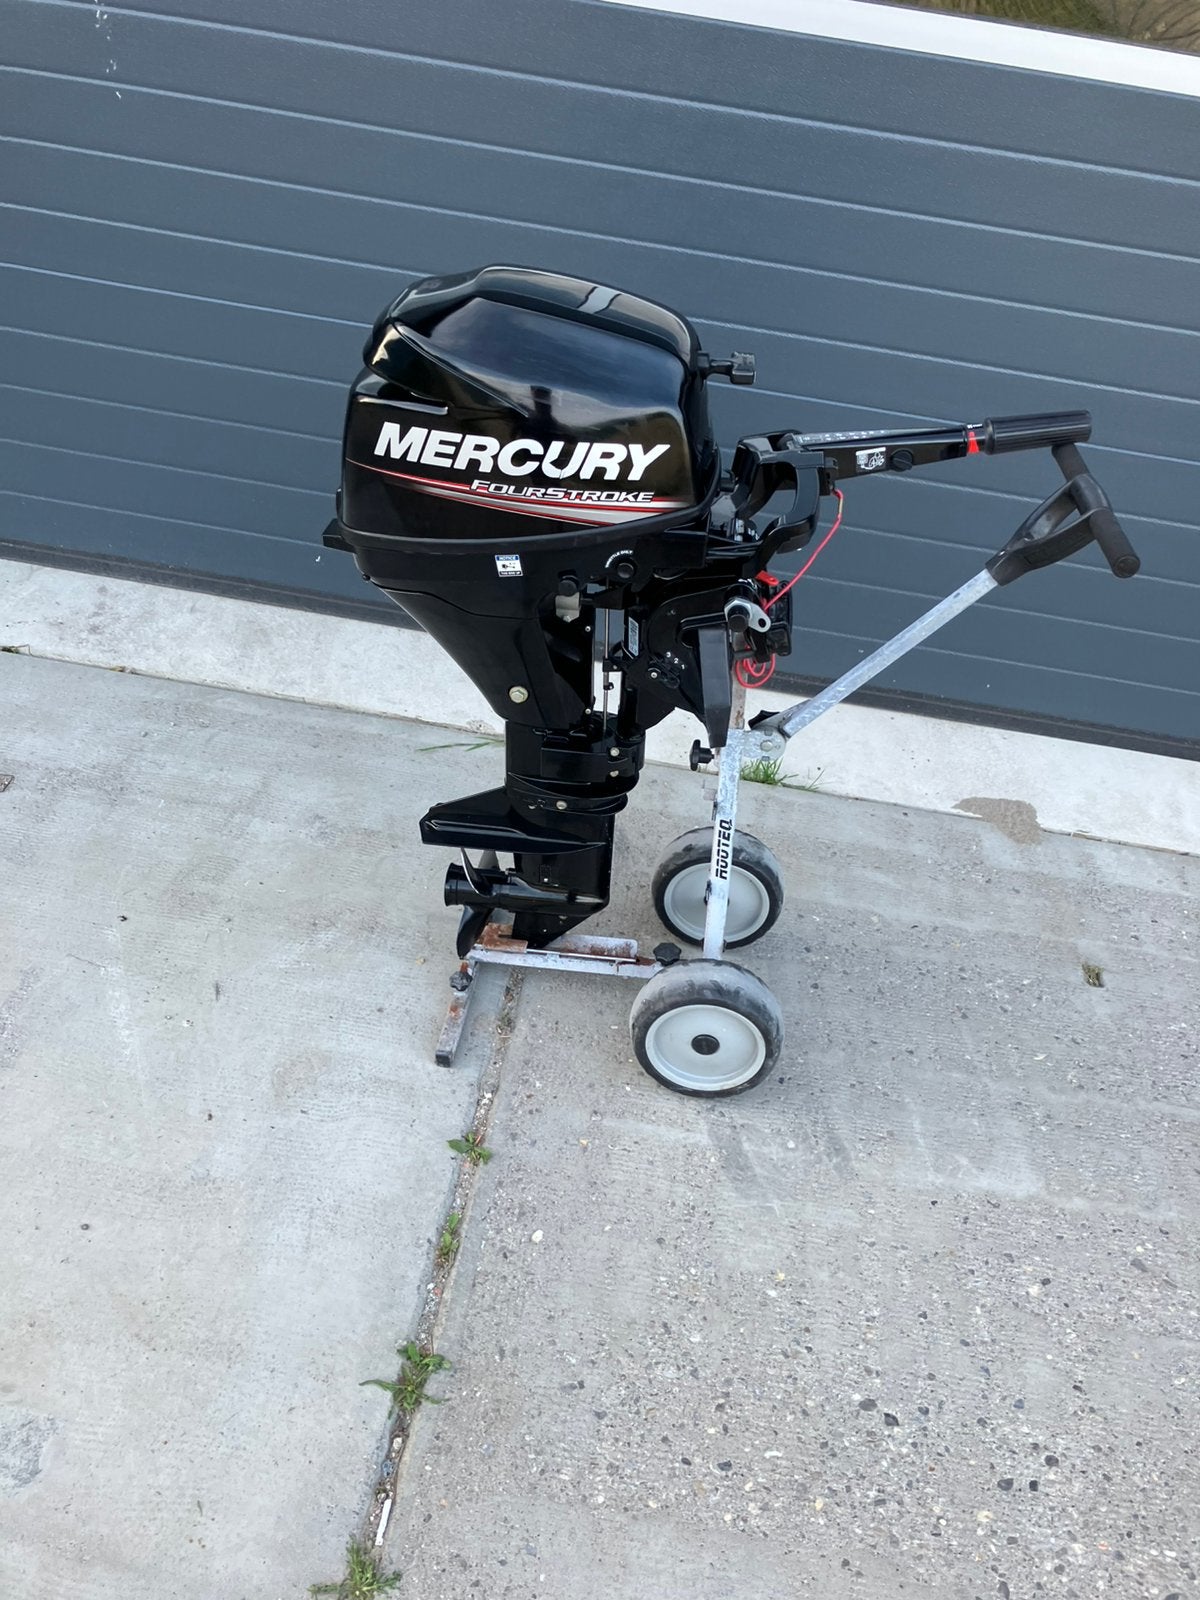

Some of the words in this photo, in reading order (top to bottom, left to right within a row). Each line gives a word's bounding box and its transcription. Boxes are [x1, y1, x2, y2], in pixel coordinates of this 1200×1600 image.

[374, 421, 671, 481] MERCURY
[470, 480, 655, 503] FOURSTROKE
[716, 819, 733, 880] ROOTEQ
